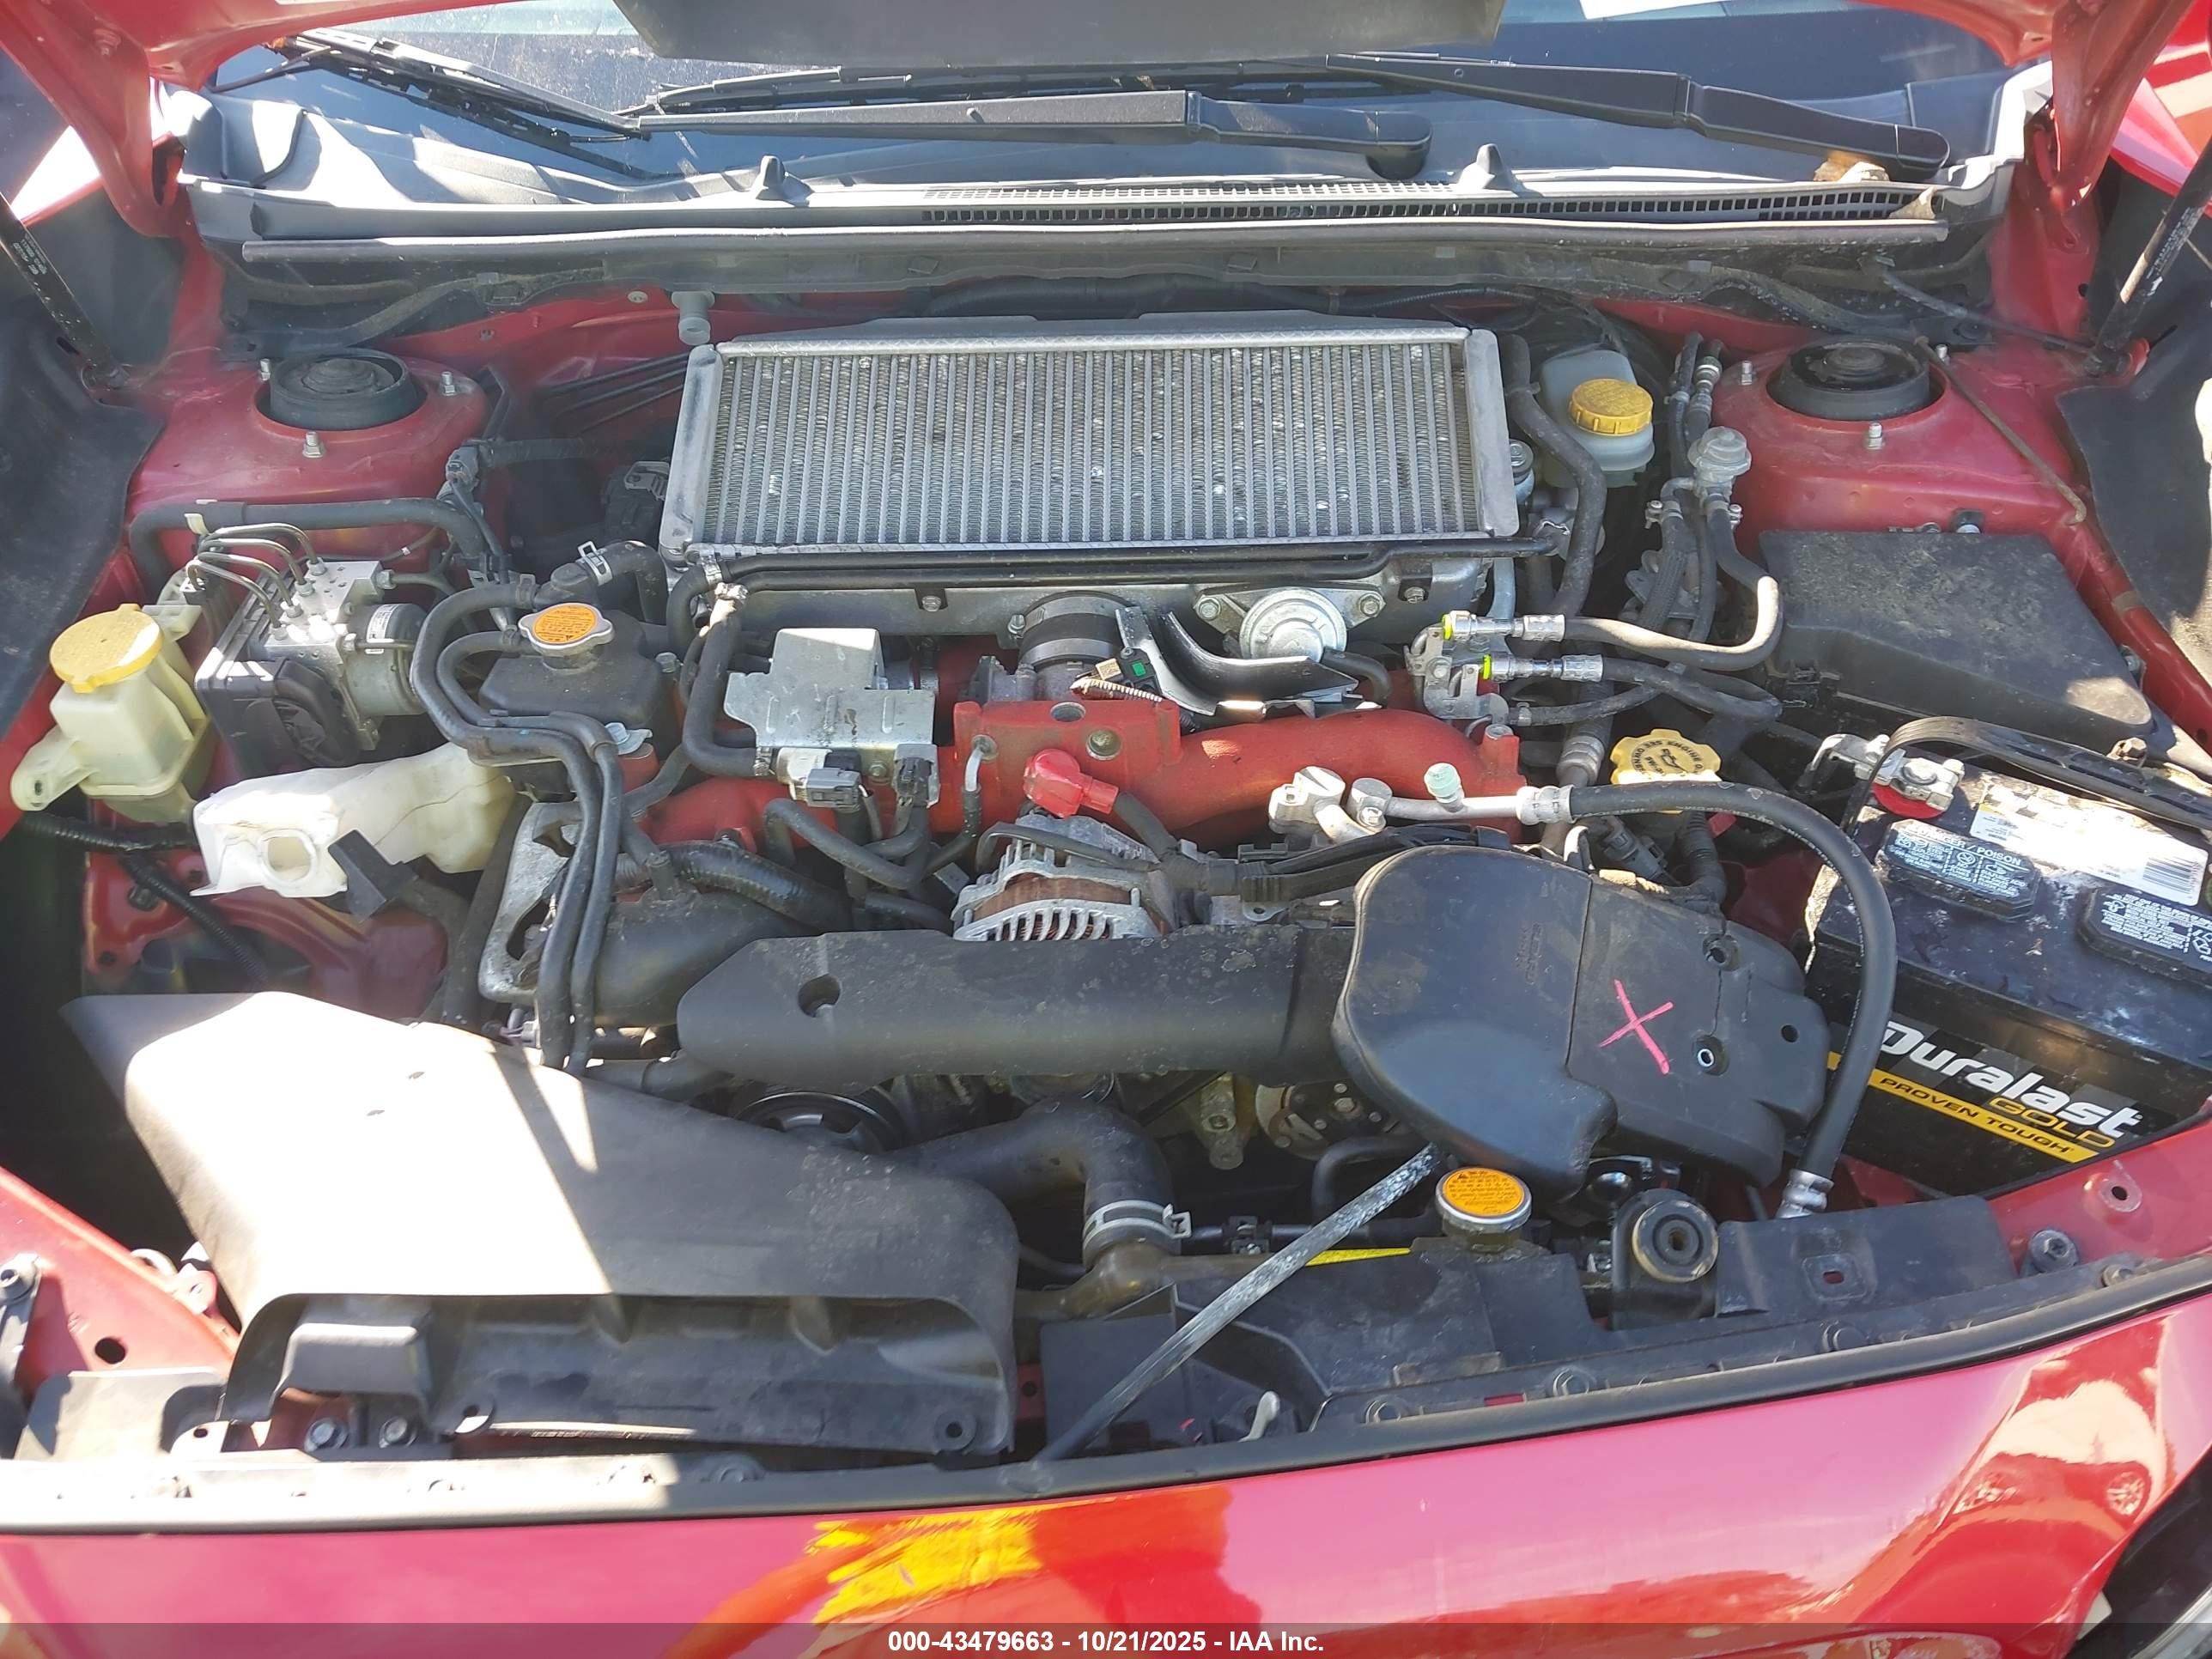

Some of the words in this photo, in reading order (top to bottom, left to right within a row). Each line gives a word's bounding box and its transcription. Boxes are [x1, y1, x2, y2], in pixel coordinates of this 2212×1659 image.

[1668, 740, 1702, 761] ENGINE
[1977, 847, 2021, 866] POISON
[1881, 1020, 2141, 1138] Duralast
[1880, 1078, 1979, 1117] PROVEN
[1986, 1116, 2071, 1153] TOUGH
[1989, 1097, 2116, 1148] GOLD
